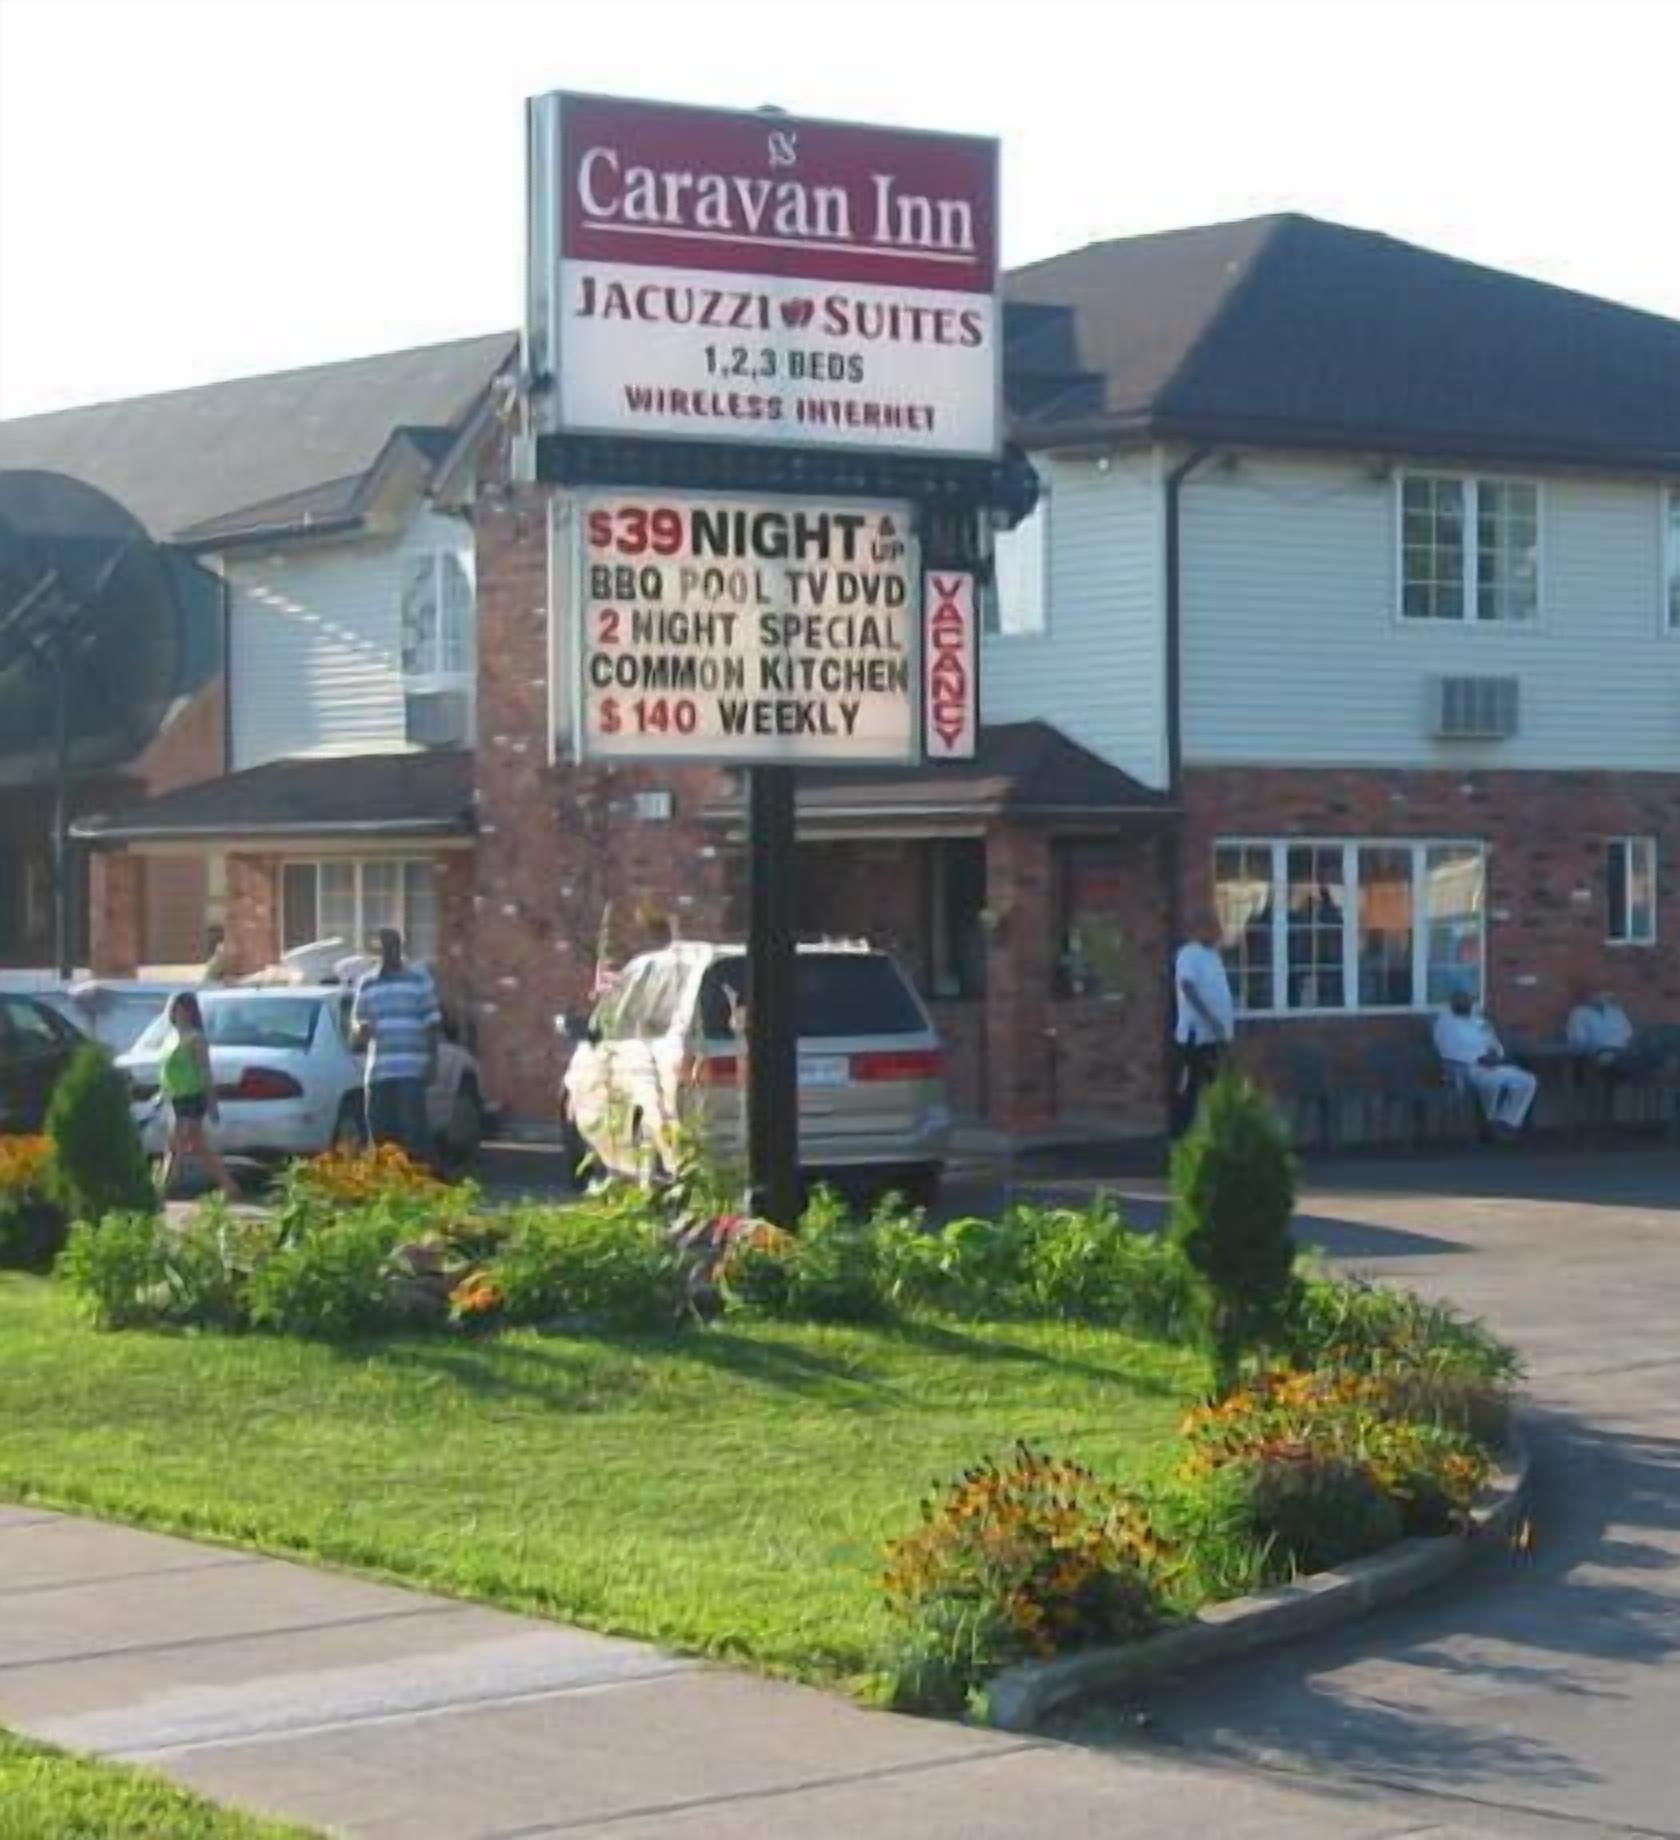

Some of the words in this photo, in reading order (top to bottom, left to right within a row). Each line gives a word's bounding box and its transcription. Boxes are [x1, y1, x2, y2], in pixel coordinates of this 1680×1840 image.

[577, 146, 852, 238] Caravan
[873, 174, 976, 250] Inn
[575, 276, 771, 331] JACUZZI
[823, 295, 983, 348] SUITES
[704, 345, 777, 381] 1,2,3
[788, 350, 865, 384] BEDS
[624, 385, 783, 421] WIRELESS
[796, 396, 935, 431] INTERNET
[589, 507, 684, 556] $39
[691, 508, 865, 561] NIGHT
[591, 564, 663, 601] BBQ
[680, 567, 771, 605] POOL
[599, 608, 620, 645] 2
[631, 608, 738, 647] NIGHT
[759, 611, 901, 650] SPECIAL
[590, 652, 745, 691] COMMON
[759, 655, 909, 693] KITCHEN
[931, 576, 967, 752] VACANCY
[717, 698, 861, 736] WEEKLY
